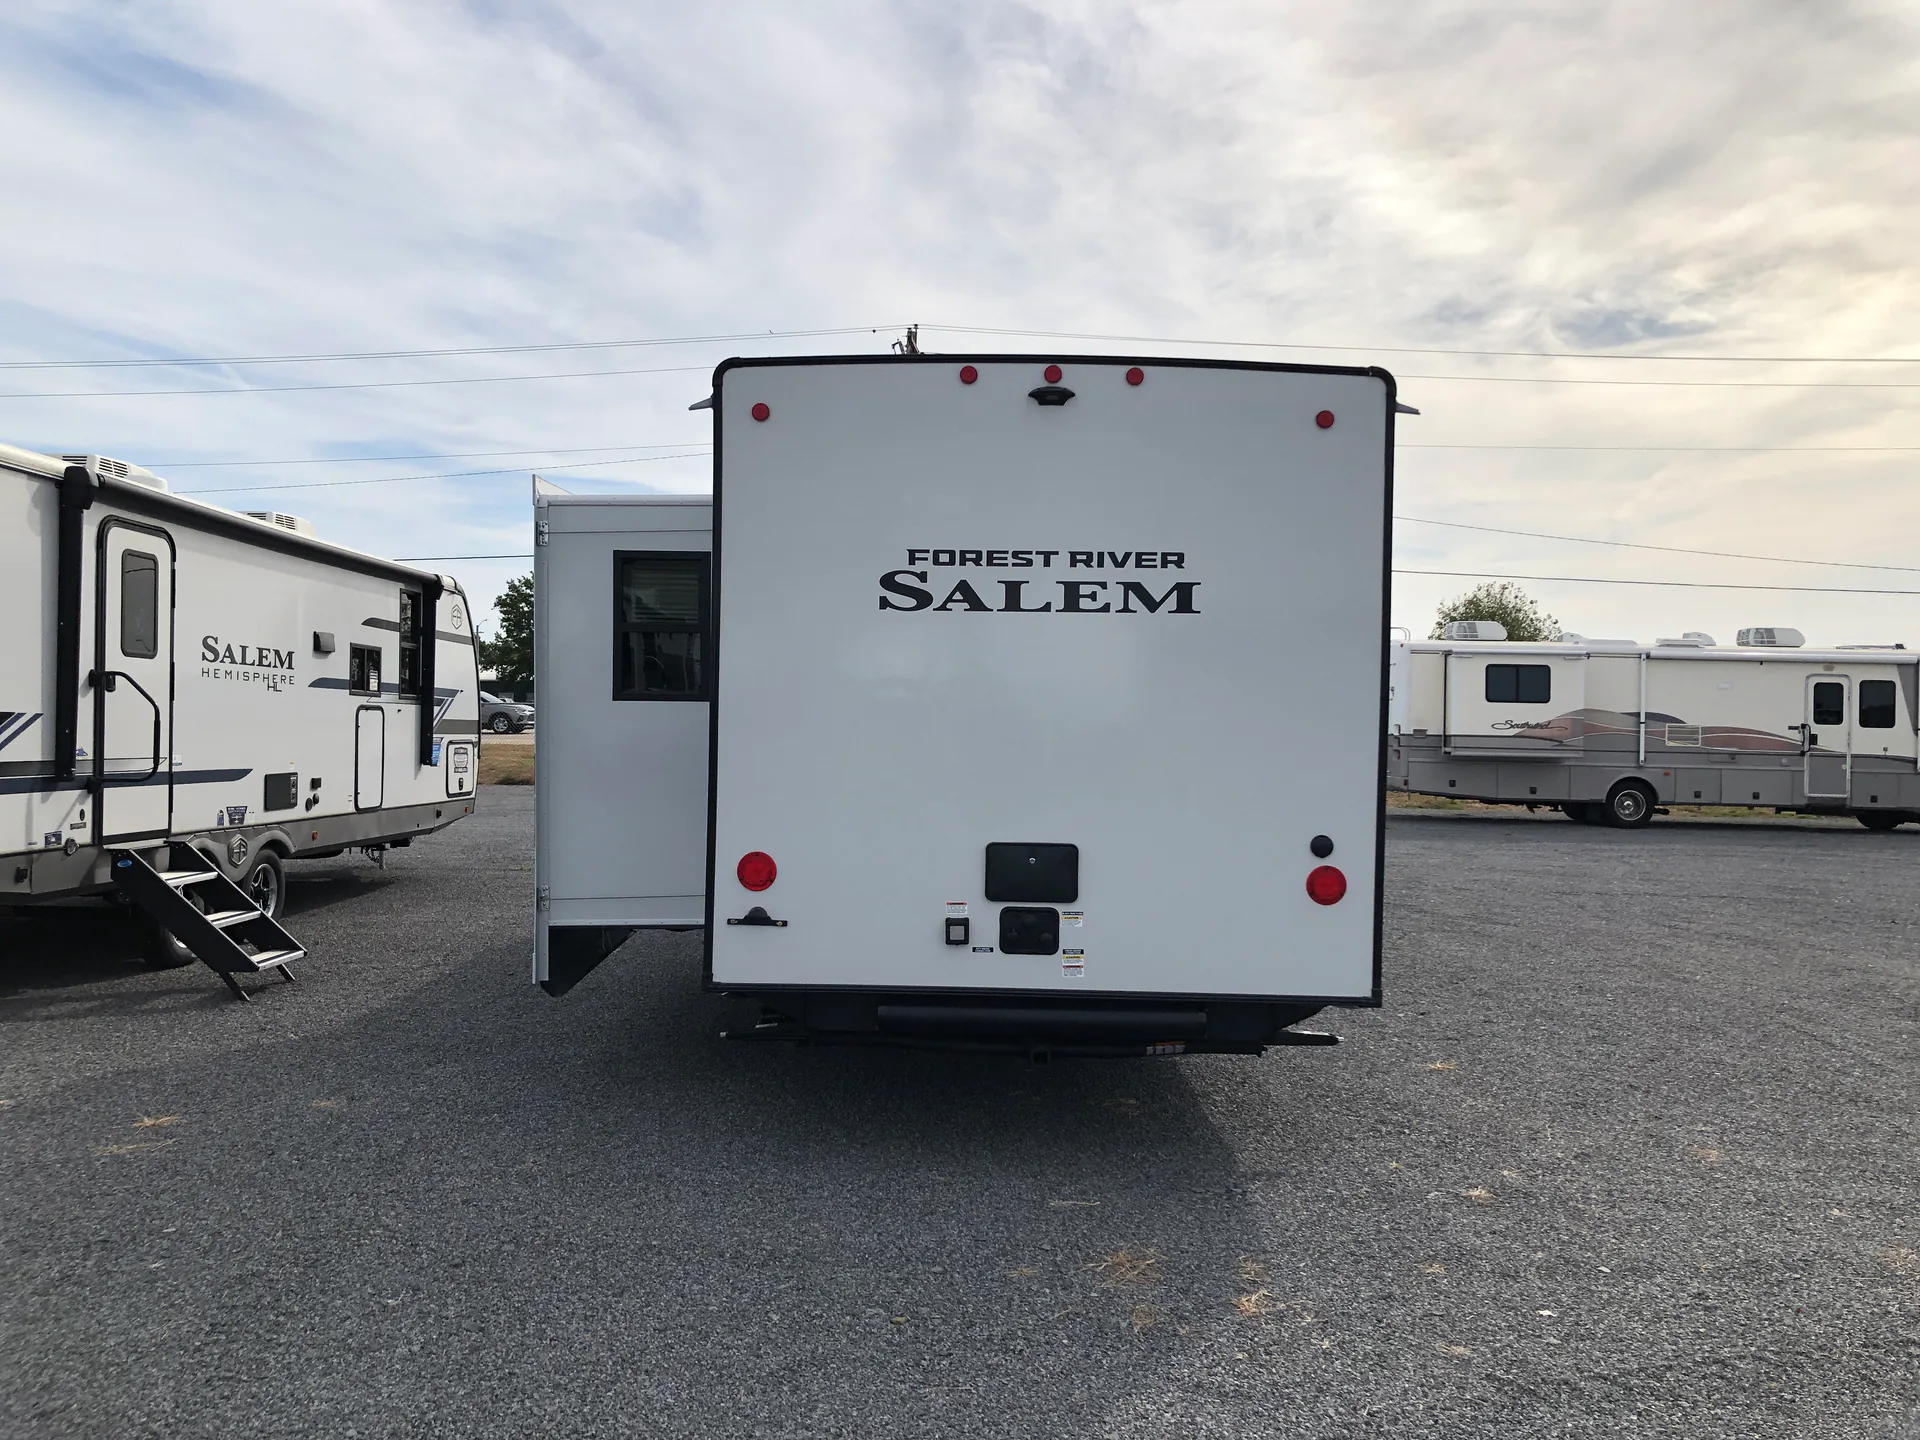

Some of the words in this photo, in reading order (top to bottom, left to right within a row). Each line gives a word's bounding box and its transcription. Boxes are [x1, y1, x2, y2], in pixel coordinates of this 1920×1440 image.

[906, 549, 1059, 568] FOREST
[1068, 551, 1185, 569] RIVER
[879, 570, 1201, 614] SALEM
[201, 635, 295, 670] SALEM
[201, 667, 295, 685] HEMISPHERE
[1491, 719, 1568, 730] Southwind
